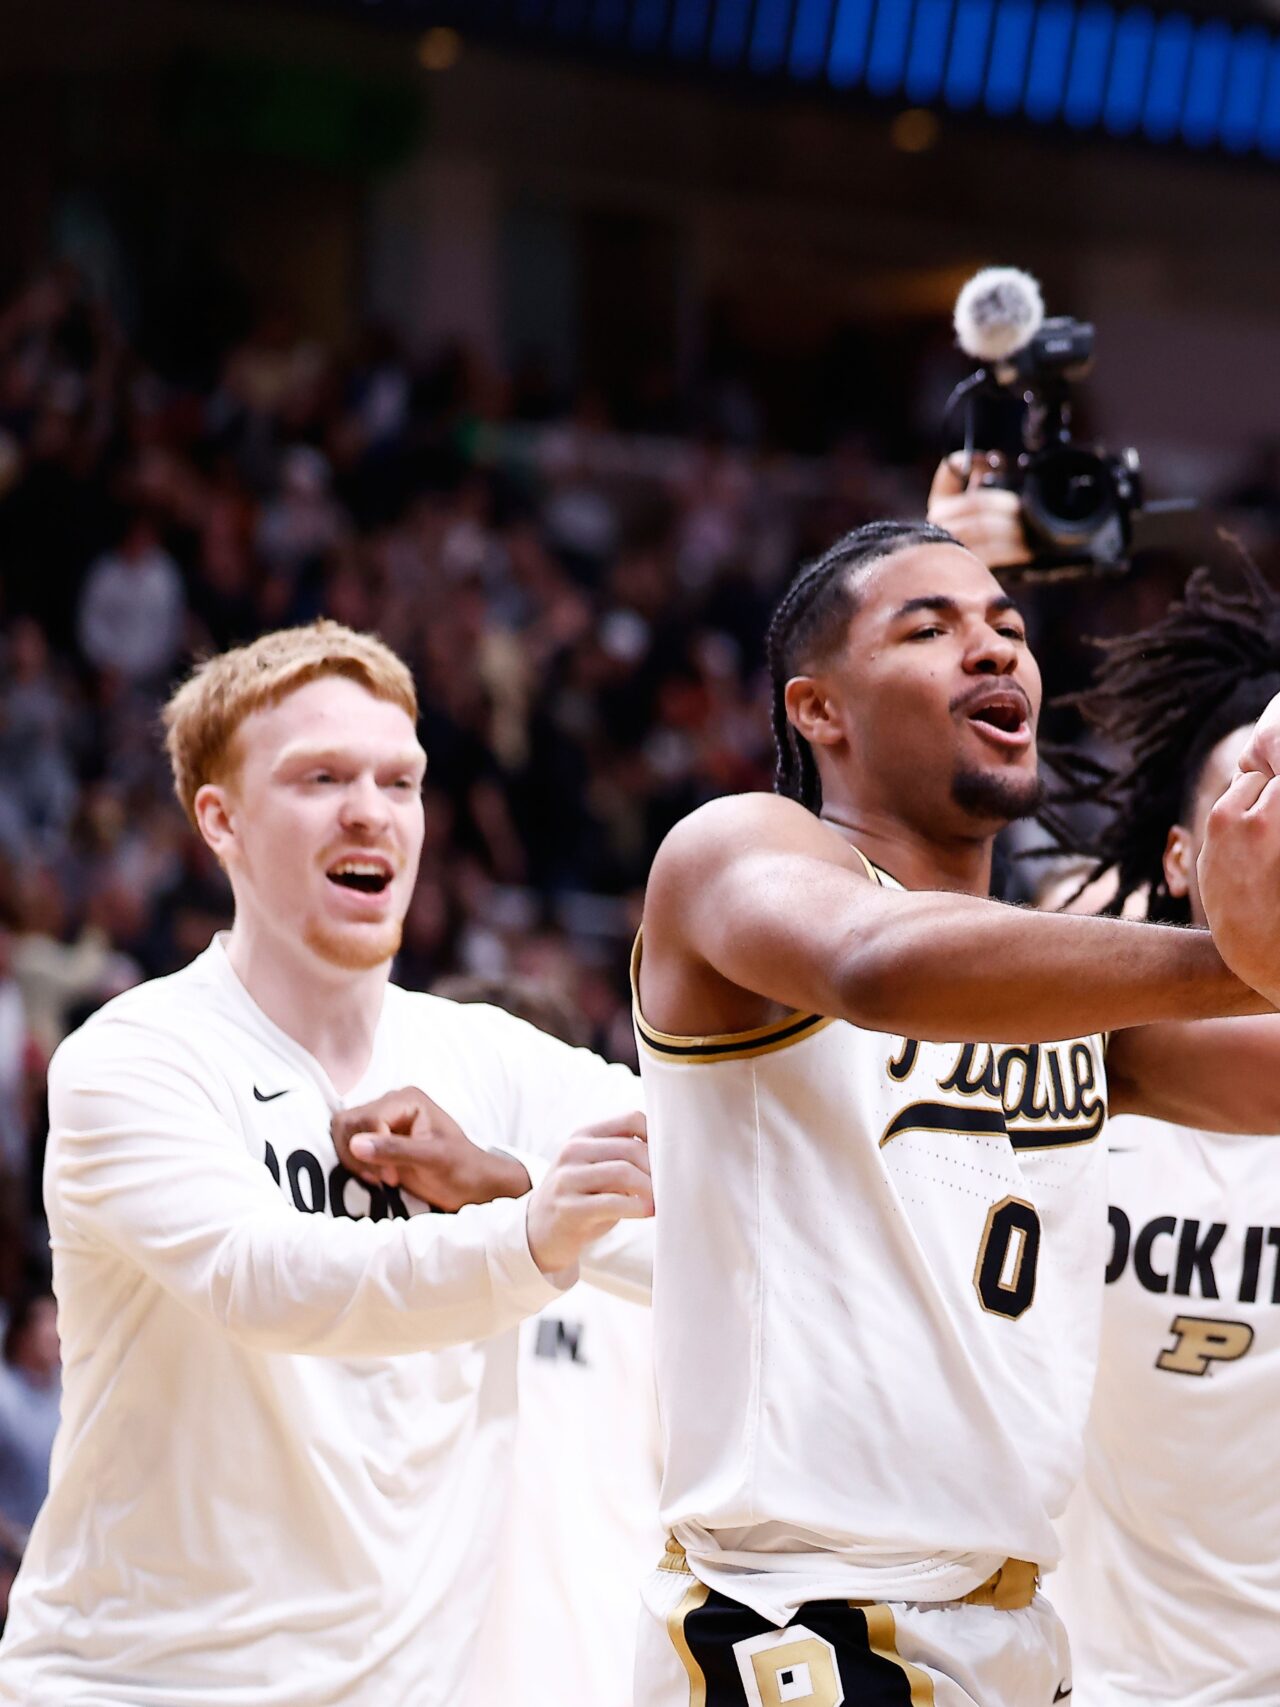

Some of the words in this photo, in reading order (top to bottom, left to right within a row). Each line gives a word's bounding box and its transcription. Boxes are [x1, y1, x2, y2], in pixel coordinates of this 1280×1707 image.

[972, 1194, 1041, 1322] 0
[1104, 1205, 1227, 1301] OCK
[1155, 1315, 1255, 1377] P
